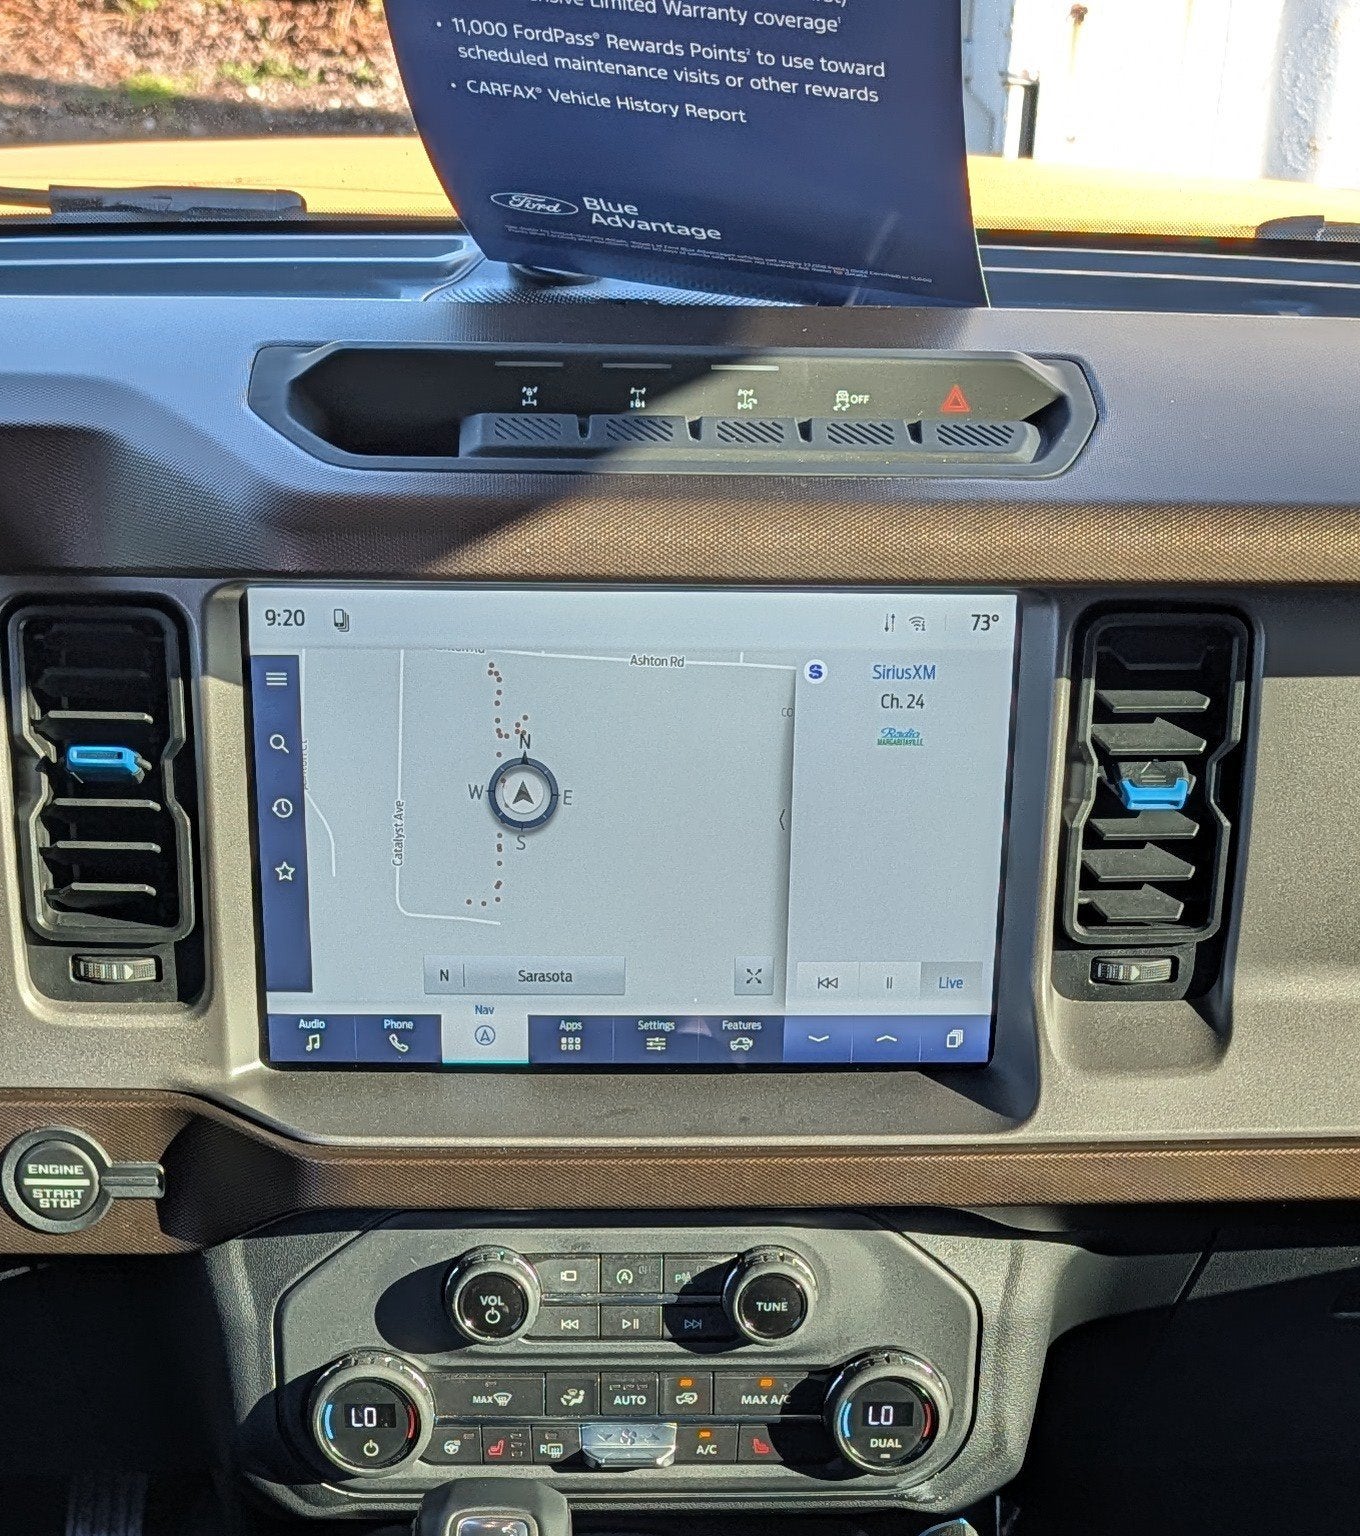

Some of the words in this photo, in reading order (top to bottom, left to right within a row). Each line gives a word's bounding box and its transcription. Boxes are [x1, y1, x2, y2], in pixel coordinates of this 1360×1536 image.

[663, 1, 747, 25] Warranty
[451, 18, 507, 37] 11,000
[606, 34, 684, 56] Rewards
[756, 51, 775, 66] to
[781, 55, 814, 70] use
[820, 57, 886, 78] toward
[457, 45, 548, 67] scheduled
[554, 57, 668, 80] maintenance
[673, 67, 720, 85] visits
[725, 75, 744, 88] or
[749, 77, 798, 94] other
[805, 83, 879, 103] rewards
[547, 88, 611, 108] Vehicle
[616, 96, 679, 118] History
[685, 104, 747, 123] Report
[582, 196, 639, 216] Blue
[591, 213, 722, 241] Advantage
[850, 394, 870, 405] OFF
[264, 609, 306, 628] 9:20
[970, 613, 1000, 632] 73°
[629, 653, 668, 668] Ashton
[669, 655, 686, 668] Rd
[872, 664, 937, 680] SiriusXM
[880, 693, 903, 709] Ch.
[906, 693, 925, 709] 24
[519, 734, 531, 750] N
[467, 783, 485, 800] W
[562, 789, 573, 806] E
[393, 800, 405, 819] Ave
[392, 821, 405, 867] Catalyst
[516, 835, 527, 851] S
[439, 969, 449, 982] N
[518, 969, 573, 984] Sarasota
[939, 976, 963, 989] Live
[474, 1004, 495, 1015] Nav
[298, 1018, 325, 1030] Audio
[383, 1018, 414, 1031] Phone
[558, 1019, 583, 1032] Apps
[637, 1019, 675, 1032] Settings
[722, 1019, 762, 1031] Features
[27, 1163, 84, 1176] ENGINE
[32, 1188, 84, 1199] START
[39, 1198, 81, 1209] STOP
[480, 1295, 505, 1307] VOL
[756, 1301, 788, 1312] TUNE
[472, 1395, 493, 1405] MAX
[613, 1395, 646, 1406] AUTO
[741, 1395, 768, 1405] MAX
[770, 1395, 791, 1405] A/C
[351, 1407, 377, 1428] LO
[868, 1405, 893, 1426] LO
[696, 1444, 717, 1455] A/C
[870, 1438, 902, 1448] DUAL
